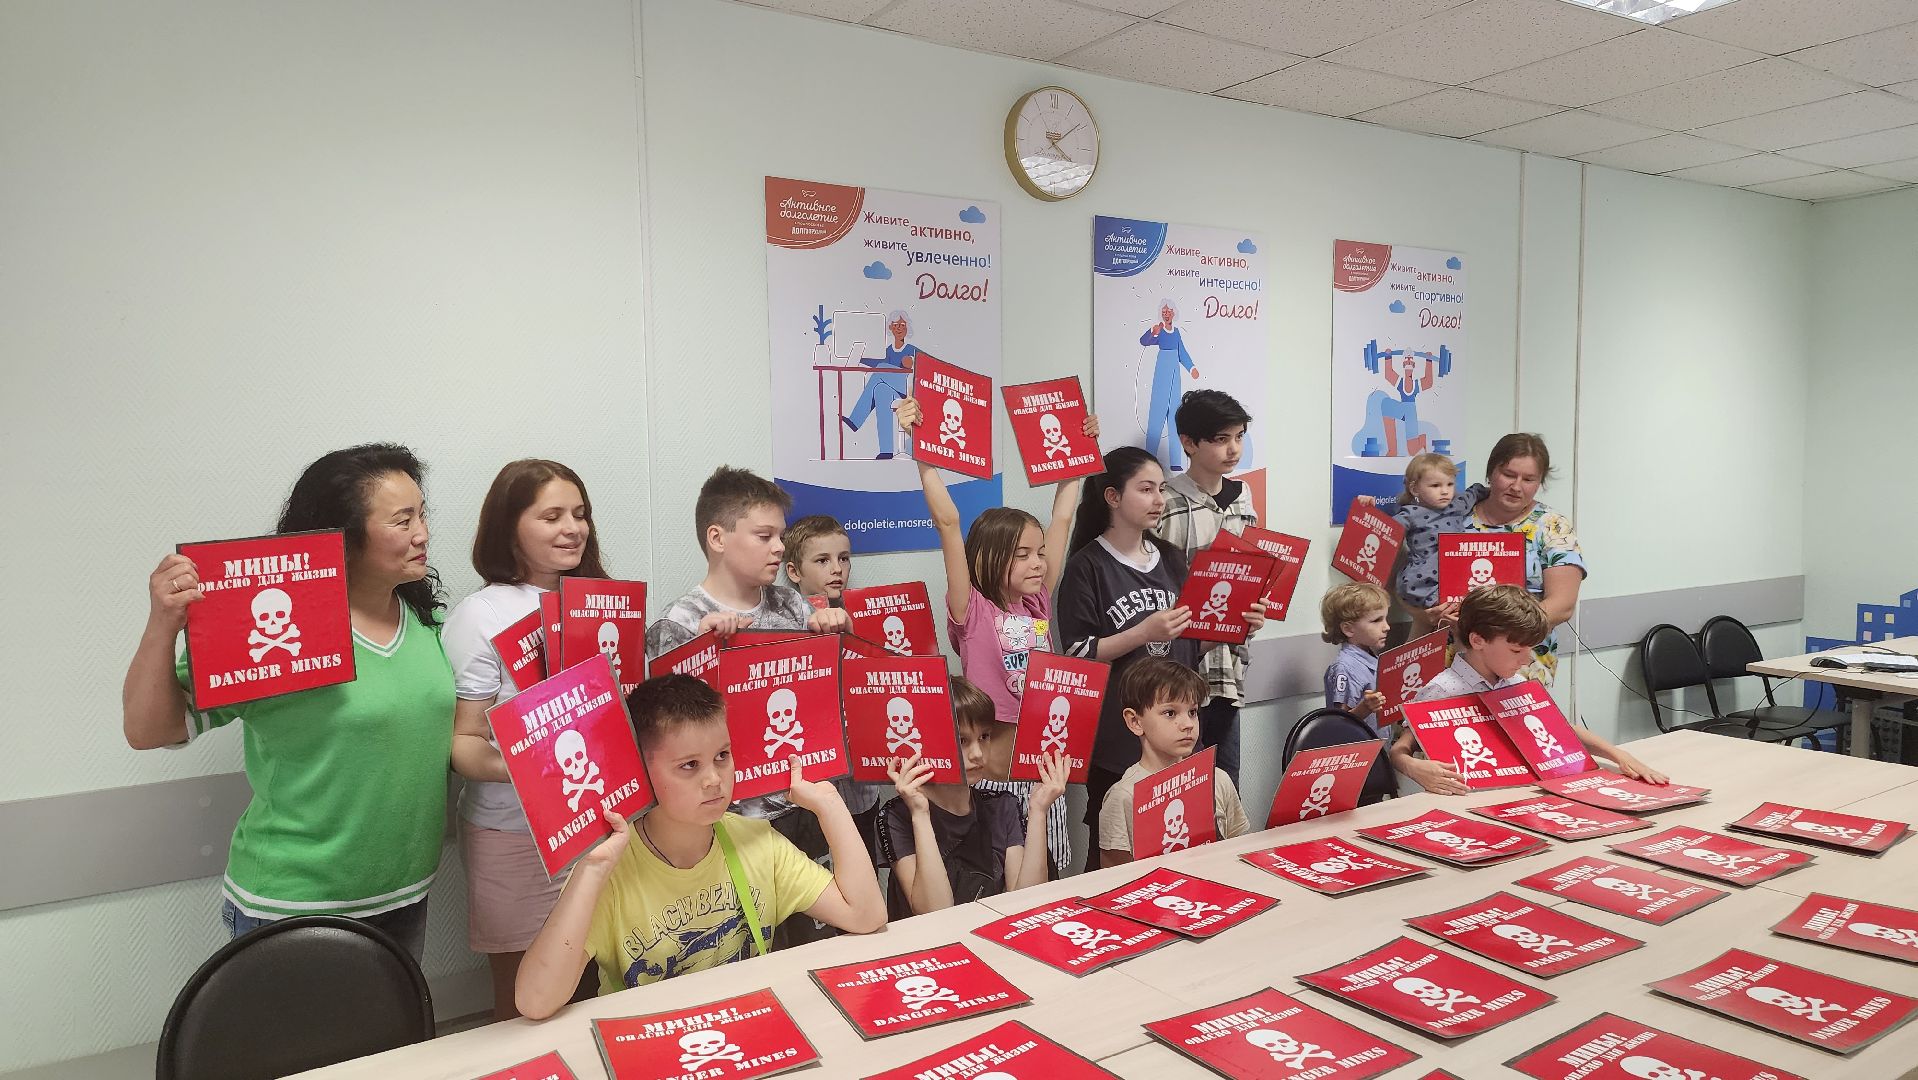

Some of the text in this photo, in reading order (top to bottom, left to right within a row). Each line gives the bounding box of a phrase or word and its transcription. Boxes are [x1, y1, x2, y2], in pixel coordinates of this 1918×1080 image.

[780, 196, 837, 212] Активное
[780, 208, 838, 223] долголетие
[863, 211, 975, 244] Живите активно,
[864, 239, 991, 268] живите увлеченно!
[1166, 245, 1249, 270] Живите активно,
[1167, 269, 1260, 291] живите интересно!
[1390, 263, 1454, 285] Живите активно,
[916, 273, 989, 302] Долго!
[1415, 292, 1463, 304] спортивно!
[1204, 296, 1258, 320] Долго!
[1419, 308, 1461, 329] Долго!
[933, 372, 974, 396] МИНЫ!
[1021, 391, 1064, 408] МИНЫ!
[920, 441, 986, 467] DANGER MINES
[1031, 453, 1095, 473] DANGER MINES
[845, 518, 935, 532] dolgoletie.mosreg.
[1459, 541, 1505, 552] МИНЫ!
[223, 553, 310, 578] МИНЫ!
[1208, 561, 1251, 575] МИНЫ!
[198, 568, 337, 592] ОПАСНО ДЛЯ ЖИЗНИ
[585, 594, 630, 609] МИНЫ!
[865, 593, 909, 609] МИНЫ!
[570, 609, 599, 618] ОПАСНО
[602, 609, 617, 619] ДЛЯ
[853, 609, 881, 618] ОПАСНО
[1186, 620, 1242, 634] NGER MINES
[210, 654, 341, 688] DANGER MINES
[513, 649, 538, 672] ОПАСНО
[748, 655, 813, 680] МИНЫ!
[728, 667, 832, 693] ОПАСНО ДЛЯ ЖИЗНИ
[866, 671, 923, 685] МИНЫ!
[1044, 667, 1087, 687] МИНЫ!
[1336, 675, 1346, 692] 6
[850, 686, 943, 694] ОПАСНО ДЛЯ ЖИЗНИ
[521, 684, 588, 734] МИНЫ!
[1384, 704, 1401, 717] DAN
[1428, 706, 1481, 721] МИНЫ!
[510, 691, 612, 756] ОПАСНО ДЛЯ ЖИЗНИ
[735, 759, 790, 783] DANGER
[1309, 753, 1359, 768] МИНЫ!
[1496, 765, 1528, 777] MINES
[1152, 767, 1195, 800] МИНЫ!
[548, 779, 640, 852] DANGER MINES
[1182, 898, 1257, 931] DANGER MINES
[1067, 928, 1163, 965] DANGER MINES
[856, 957, 941, 981] МИНЫ!
[925, 958, 971, 972] ЖИЗНИ
[1523, 950, 1578, 969] DANGER
[642, 1007, 739, 1034] МИНЫ!
[873, 992, 1009, 1027] DANGER MINES
[1191, 1006, 1272, 1035] МИНЫ!
[1426, 989, 1527, 1029] DANGER MINES
[616, 1029, 674, 1042] ОПАСНО
[721, 1007, 772, 1025] ЖИЗНИ
[1808, 1017, 1860, 1040] DANGER
[734, 1047, 798, 1071] MINES
[913, 1043, 1005, 1080] МИНЫ!
[958, 1040, 1039, 1079] ДЛЯ ЖИЗНИ
[1335, 1046, 1388, 1070] MINES
[1558, 1032, 1629, 1069] МИНЫ!
